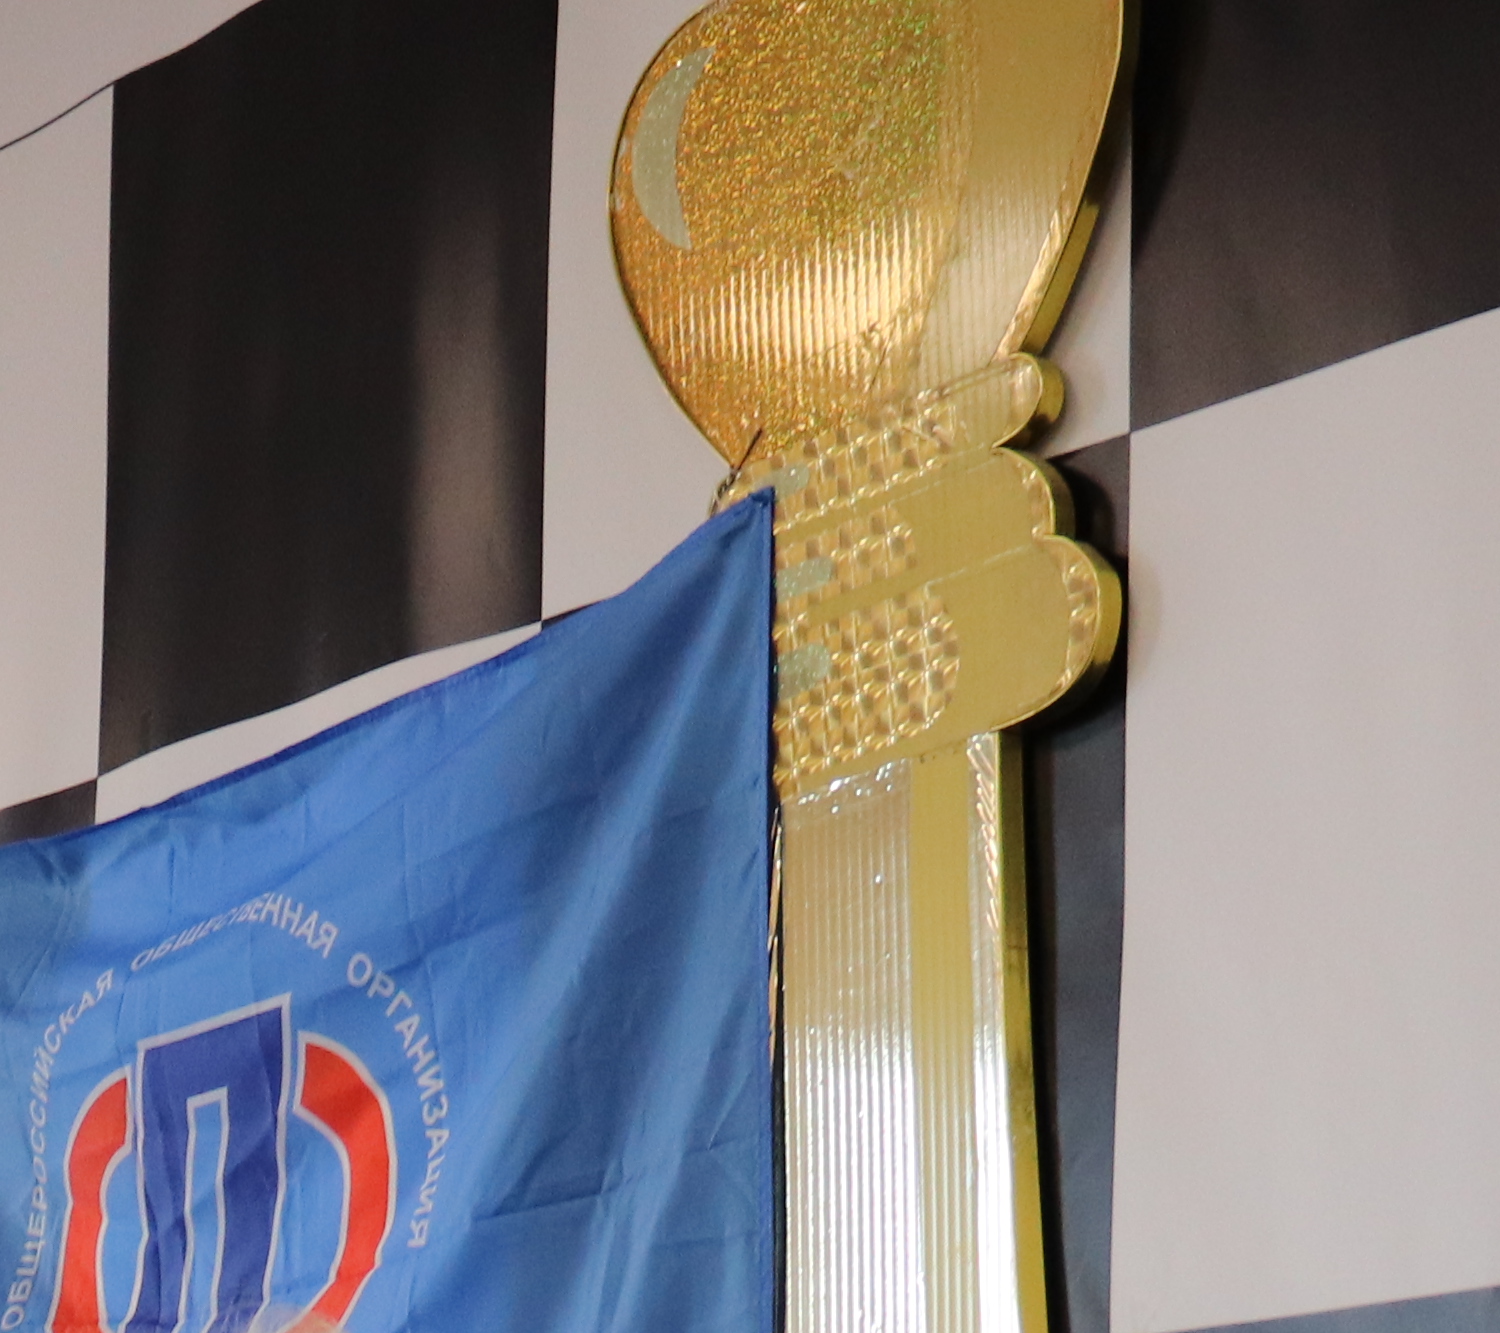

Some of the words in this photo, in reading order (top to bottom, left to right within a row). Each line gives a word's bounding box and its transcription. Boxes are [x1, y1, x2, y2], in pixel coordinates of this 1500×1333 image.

[0, 968, 114, 1331] ОБЩЕРОССИЙСКАЯ
[130, 892, 338, 972] ОБЩЕСТВЕННАЯ
[346, 952, 450, 1248] ОРГАНИЗАЦИЯ
